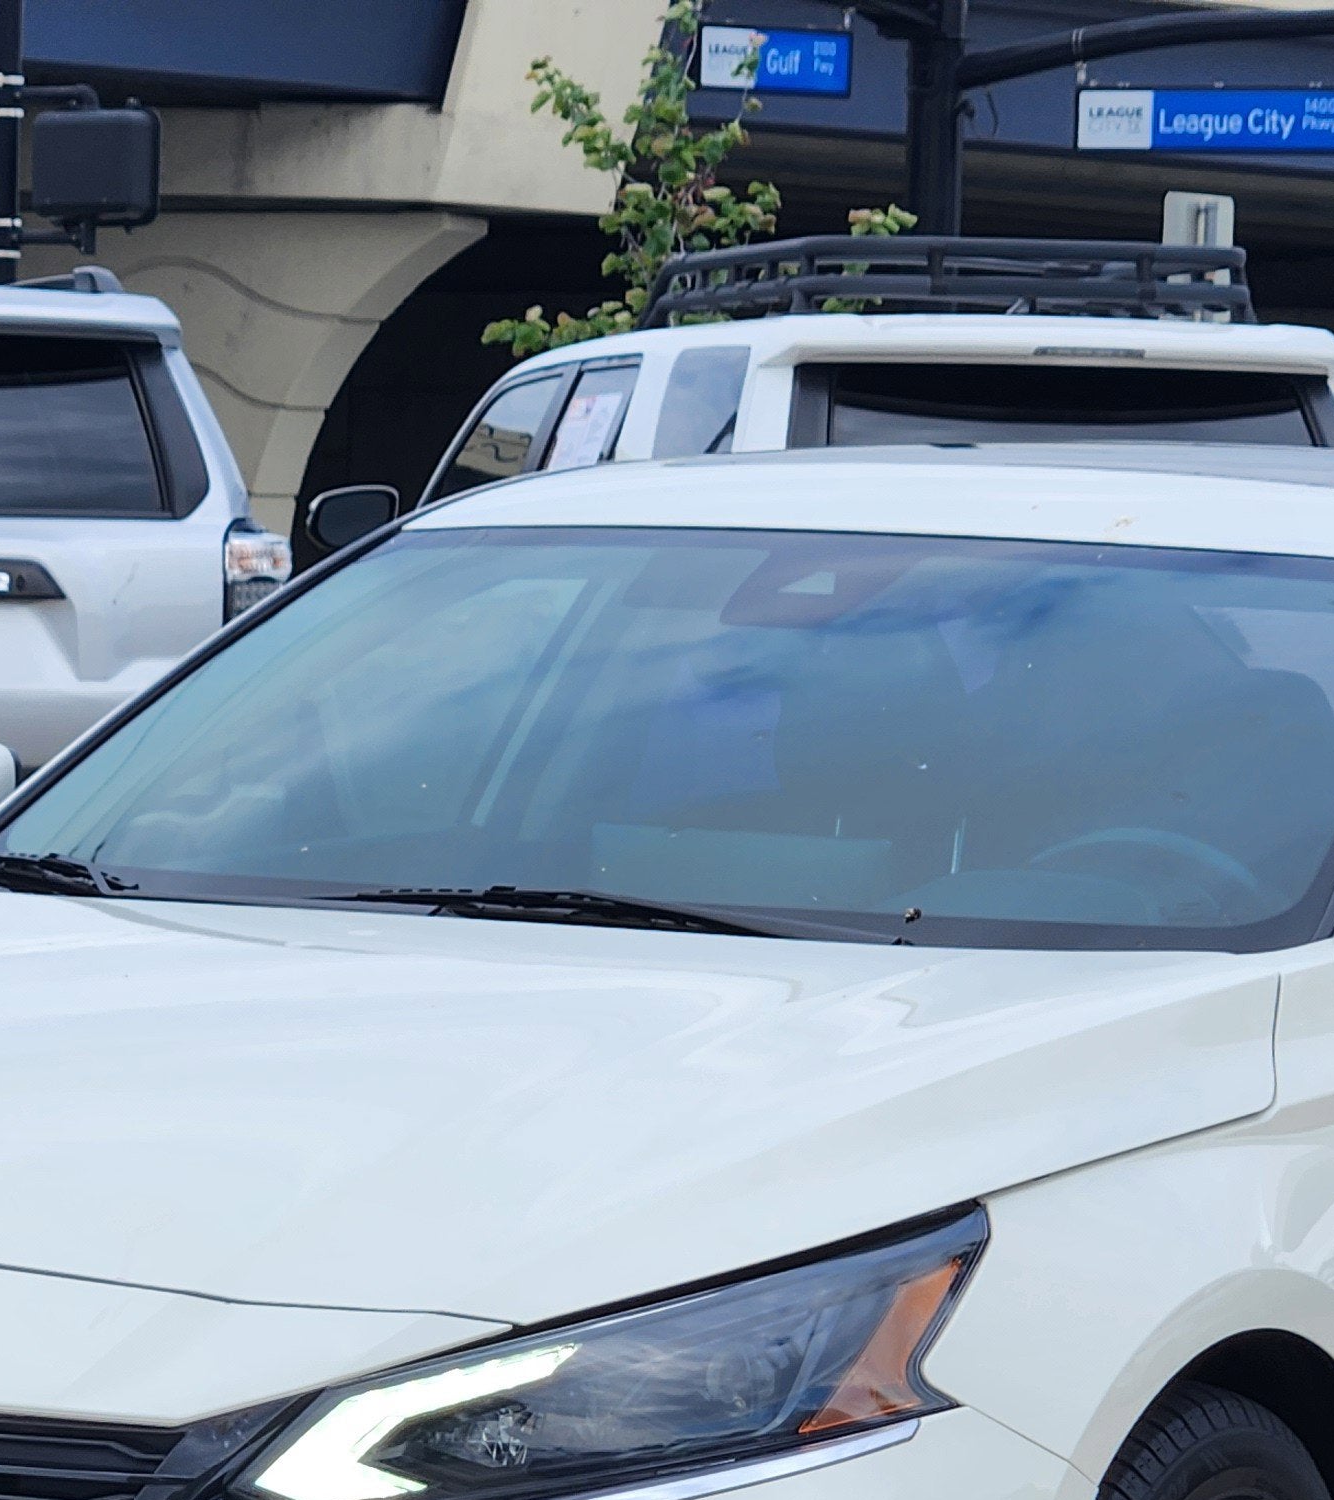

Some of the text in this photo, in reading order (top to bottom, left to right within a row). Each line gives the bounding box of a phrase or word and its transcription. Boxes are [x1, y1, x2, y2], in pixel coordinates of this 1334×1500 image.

[767, 47, 801, 76] Gulf
[1088, 106, 1143, 118] LEAGUE
[1159, 108, 1295, 142] League City
